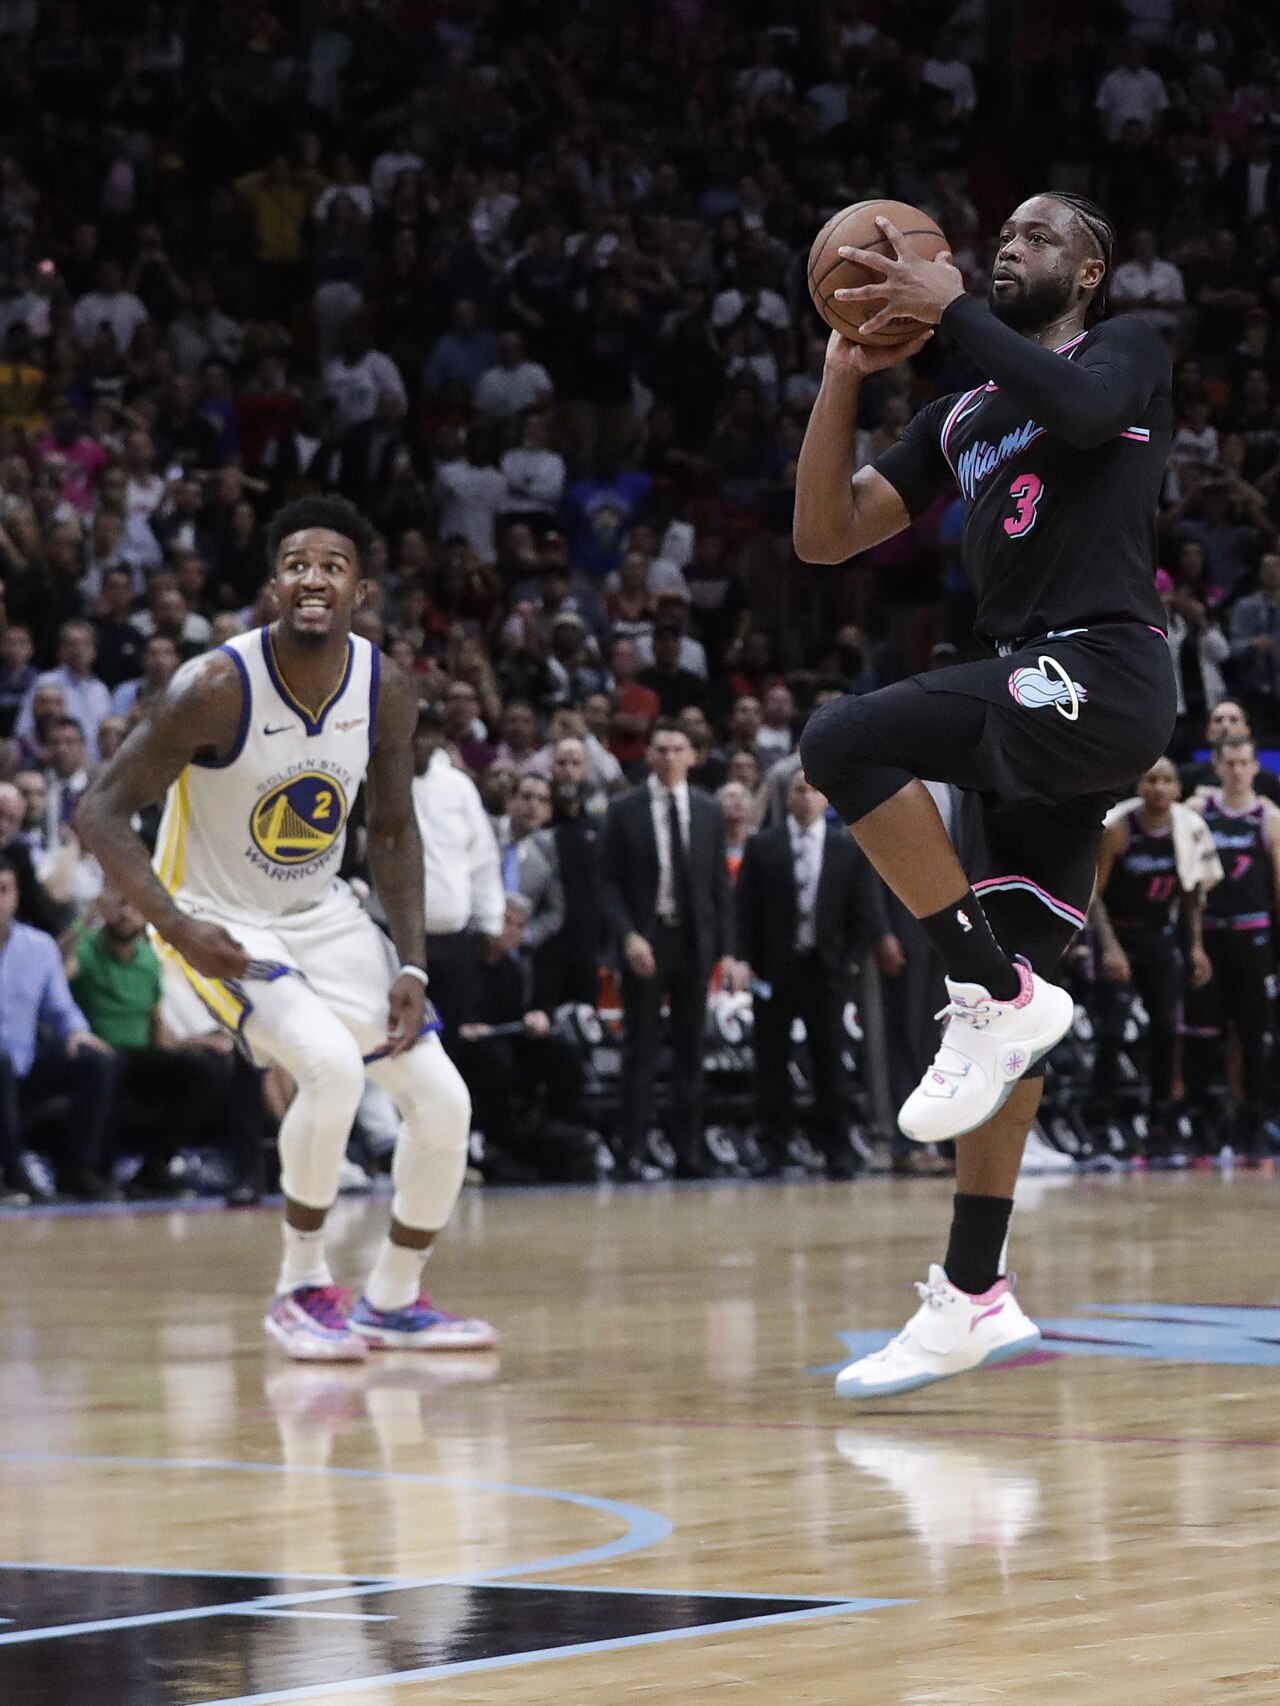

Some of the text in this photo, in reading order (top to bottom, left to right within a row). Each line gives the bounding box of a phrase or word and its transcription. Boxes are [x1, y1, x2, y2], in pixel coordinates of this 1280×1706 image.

[957, 419, 1048, 500] Miami
[1003, 473, 1044, 539] 3
[312, 791, 332, 819] 2
